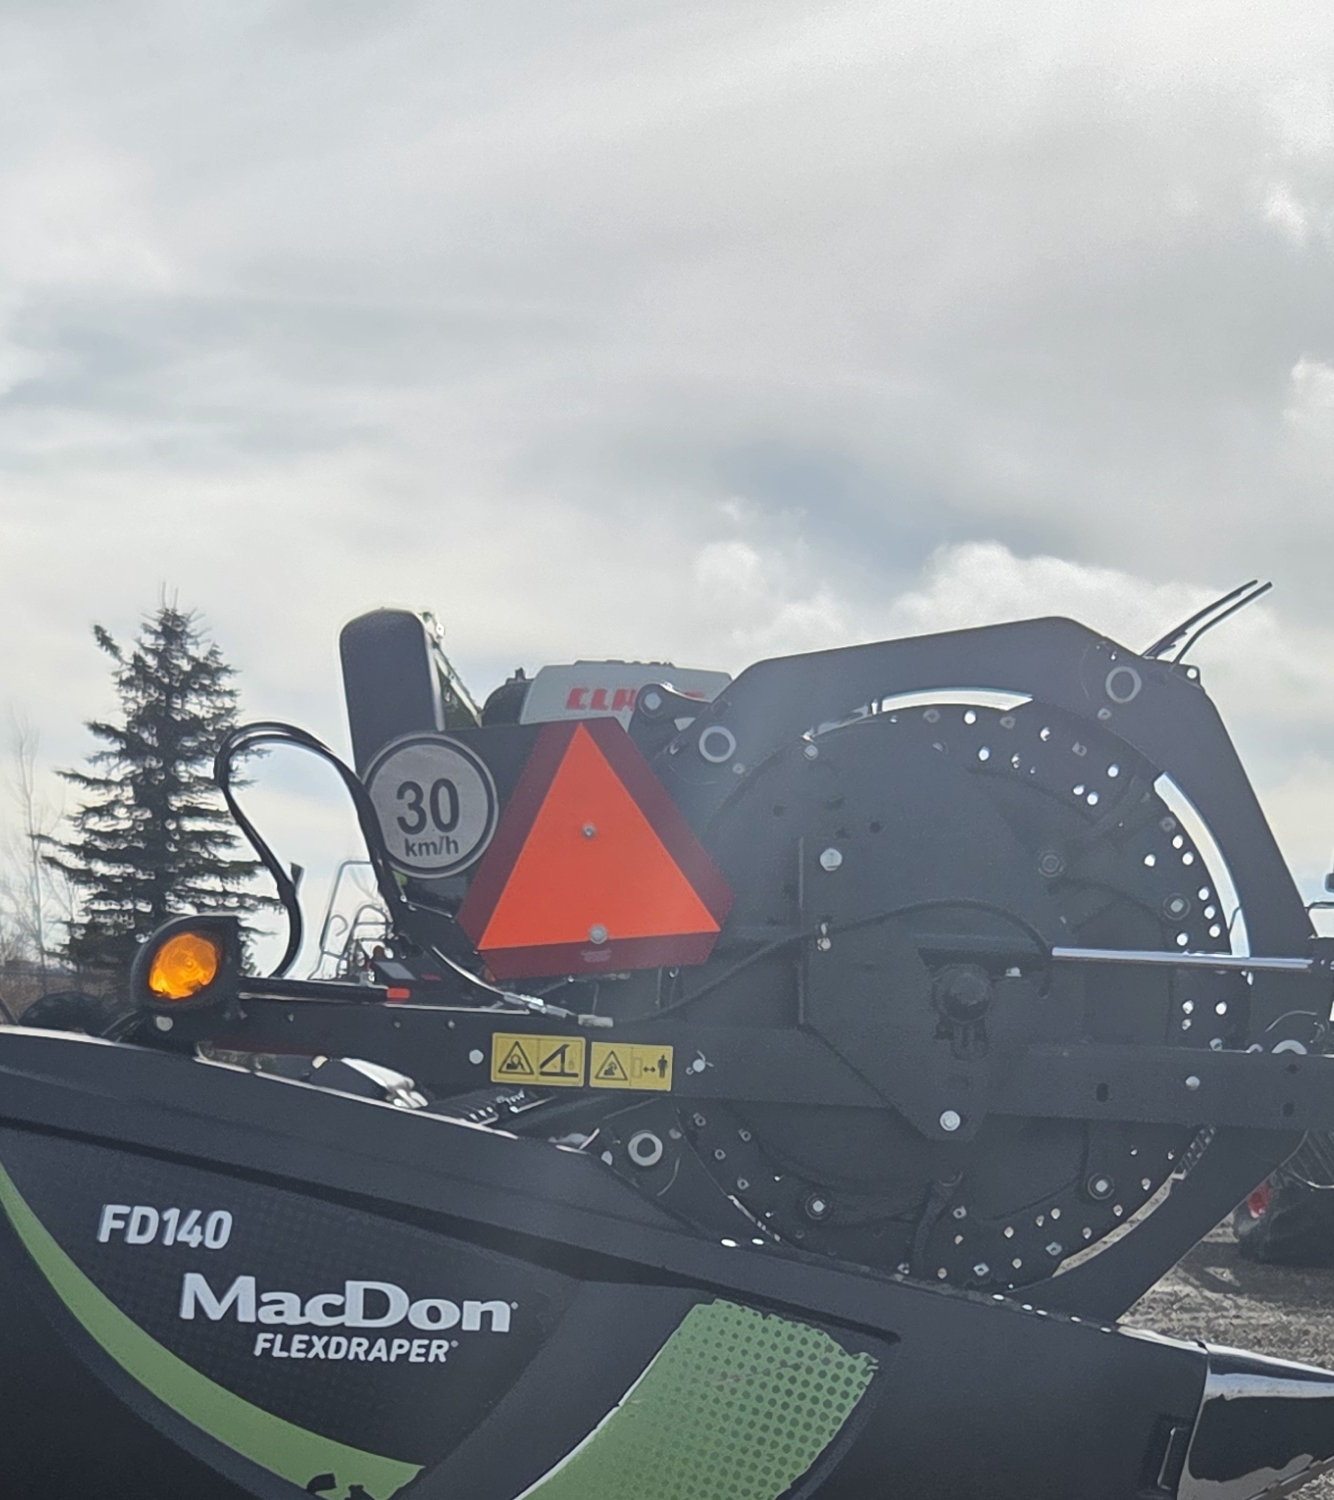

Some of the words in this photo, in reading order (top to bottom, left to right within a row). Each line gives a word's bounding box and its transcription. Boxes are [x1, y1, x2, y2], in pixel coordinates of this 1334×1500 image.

[396, 778, 460, 835] 30
[404, 836, 460, 858] km/h
[98, 1204, 233, 1250] FD140
[180, 1272, 512, 1333] MacDon
[253, 1333, 450, 1364] FLEXDRAPER
